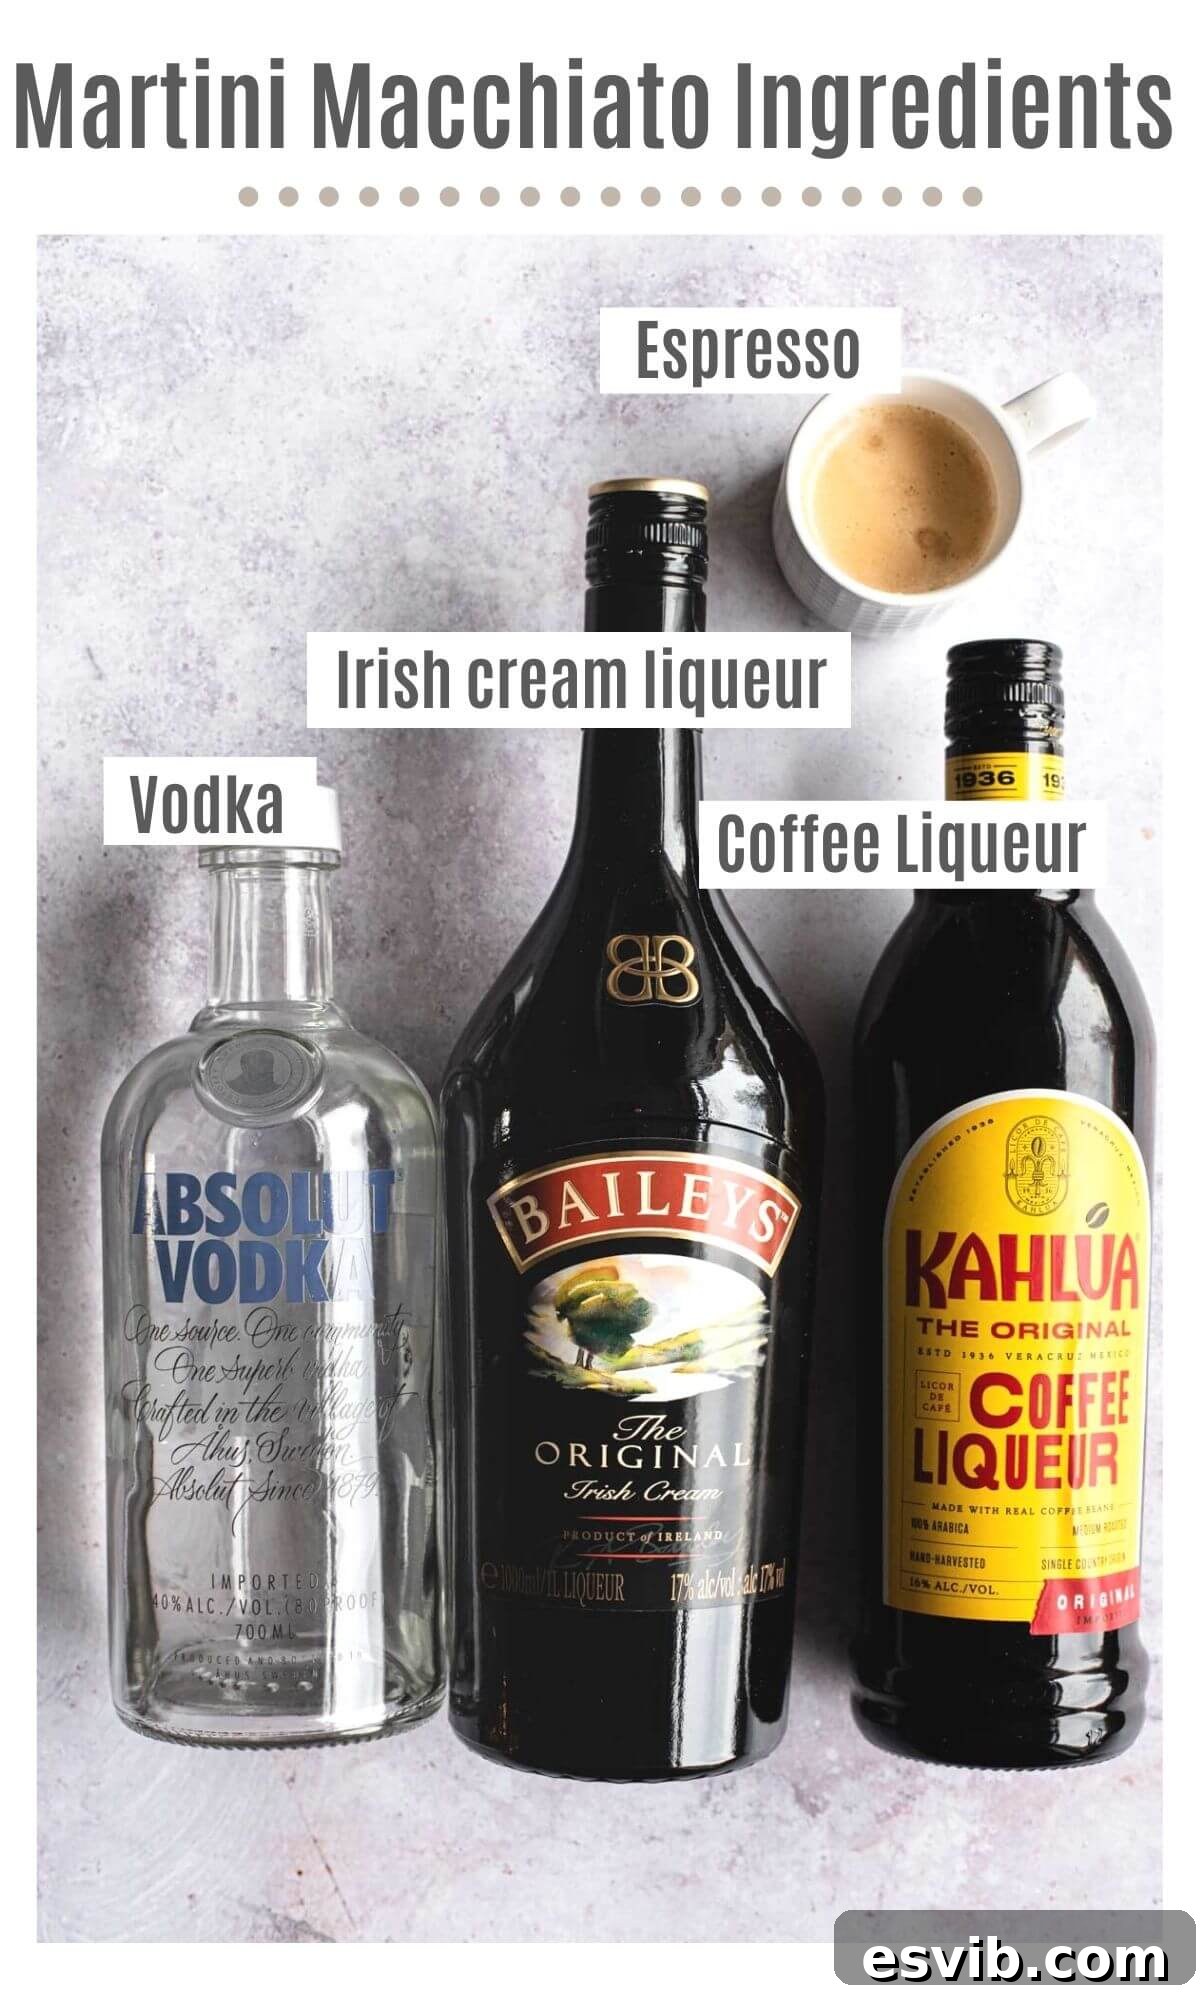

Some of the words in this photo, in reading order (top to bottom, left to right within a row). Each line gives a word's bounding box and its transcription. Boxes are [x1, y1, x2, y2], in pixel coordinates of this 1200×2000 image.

[955, 771, 1015, 788] 1936
[132, 1169, 395, 1237] ABSOLUT
[511, 1171, 780, 1244] BAILEYS
[153, 1239, 375, 1304] VODKA
[123, 1304, 170, 1346] One
[244, 1306, 297, 1349] One
[916, 1317, 979, 1339] THE
[991, 1320, 1131, 1340] ORIGINAL
[154, 1346, 215, 1384] One
[961, 1350, 995, 1360] 1936
[1006, 1352, 1082, 1361] VERACRUZ
[920, 1380, 954, 1391] LICOR
[929, 1391, 944, 1401] DE
[969, 1370, 1129, 1429] COFFEE
[121, 1379, 208, 1442] Crafted
[214, 1401, 240, 1425] in
[238, 1382, 288, 1425] the
[612, 1414, 687, 1442] The
[535, 1440, 751, 1469] ORIGINAL
[914, 1426, 1119, 1490] LIQUEUR
[151, 1466, 252, 1511] Absolut
[564, 1479, 636, 1501] Irish
[643, 1479, 723, 1501] Cream
[932, 1502, 963, 1512] MADE
[969, 1504, 1000, 1515] WITH
[1005, 1505, 1035, 1515] REAL
[1040, 1505, 1081, 1516] COFFEE
[562, 1529, 635, 1542] PRODUCT
[640, 1531, 654, 1544] of
[657, 1530, 723, 1542] IRELAND
[931, 1519, 970, 1534] ARABICA
[910, 1551, 986, 1570] HAND-HARVESTED
[1041, 1558, 1072, 1570] SINGLE
[211, 1573, 320, 1591] IMPORTED
[564, 1571, 626, 1608] LIQUEUR
[670, 1572, 695, 1602] 17%
[743, 1565, 758, 1595] alc
[909, 1577, 931, 1590] 16%
[934, 1579, 1000, 1596] ALC./VOL.
[1056, 1583, 1135, 1611] ORIGINAL
